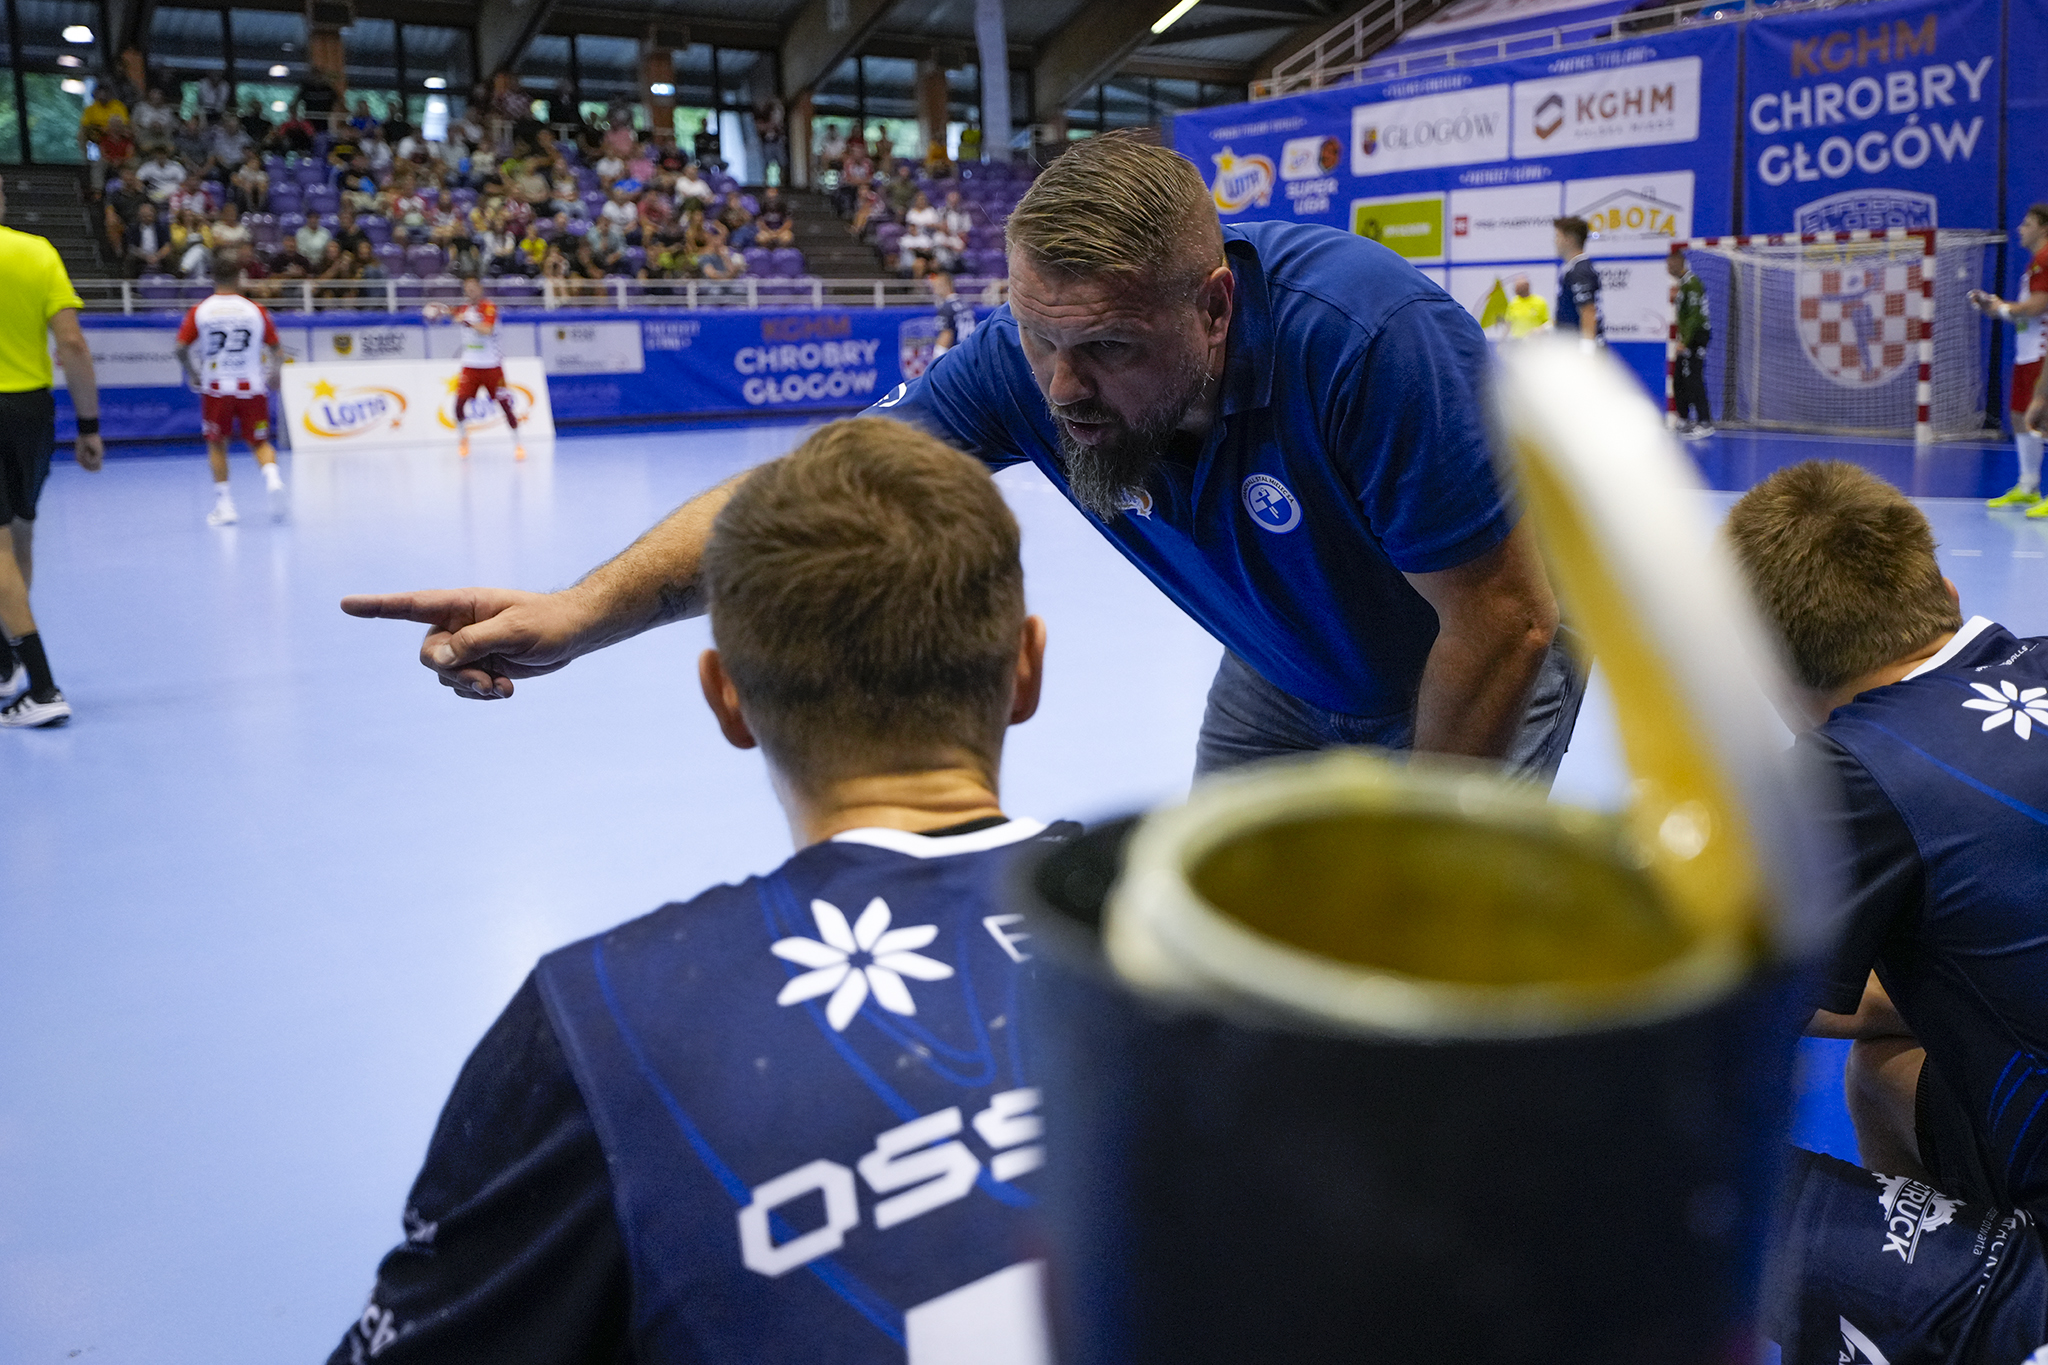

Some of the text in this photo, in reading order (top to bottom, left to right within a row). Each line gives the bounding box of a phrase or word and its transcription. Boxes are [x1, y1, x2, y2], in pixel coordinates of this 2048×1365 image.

[1790, 14, 1937, 78] KGHM
[1576, 83, 1675, 122] KGHM
[1750, 55, 1993, 135] CHROBRY
[1758, 113, 1984, 186] GŁOGÓW
[1587, 206, 1676, 238] OBOTA
[734, 338, 880, 375] CHROBRY
